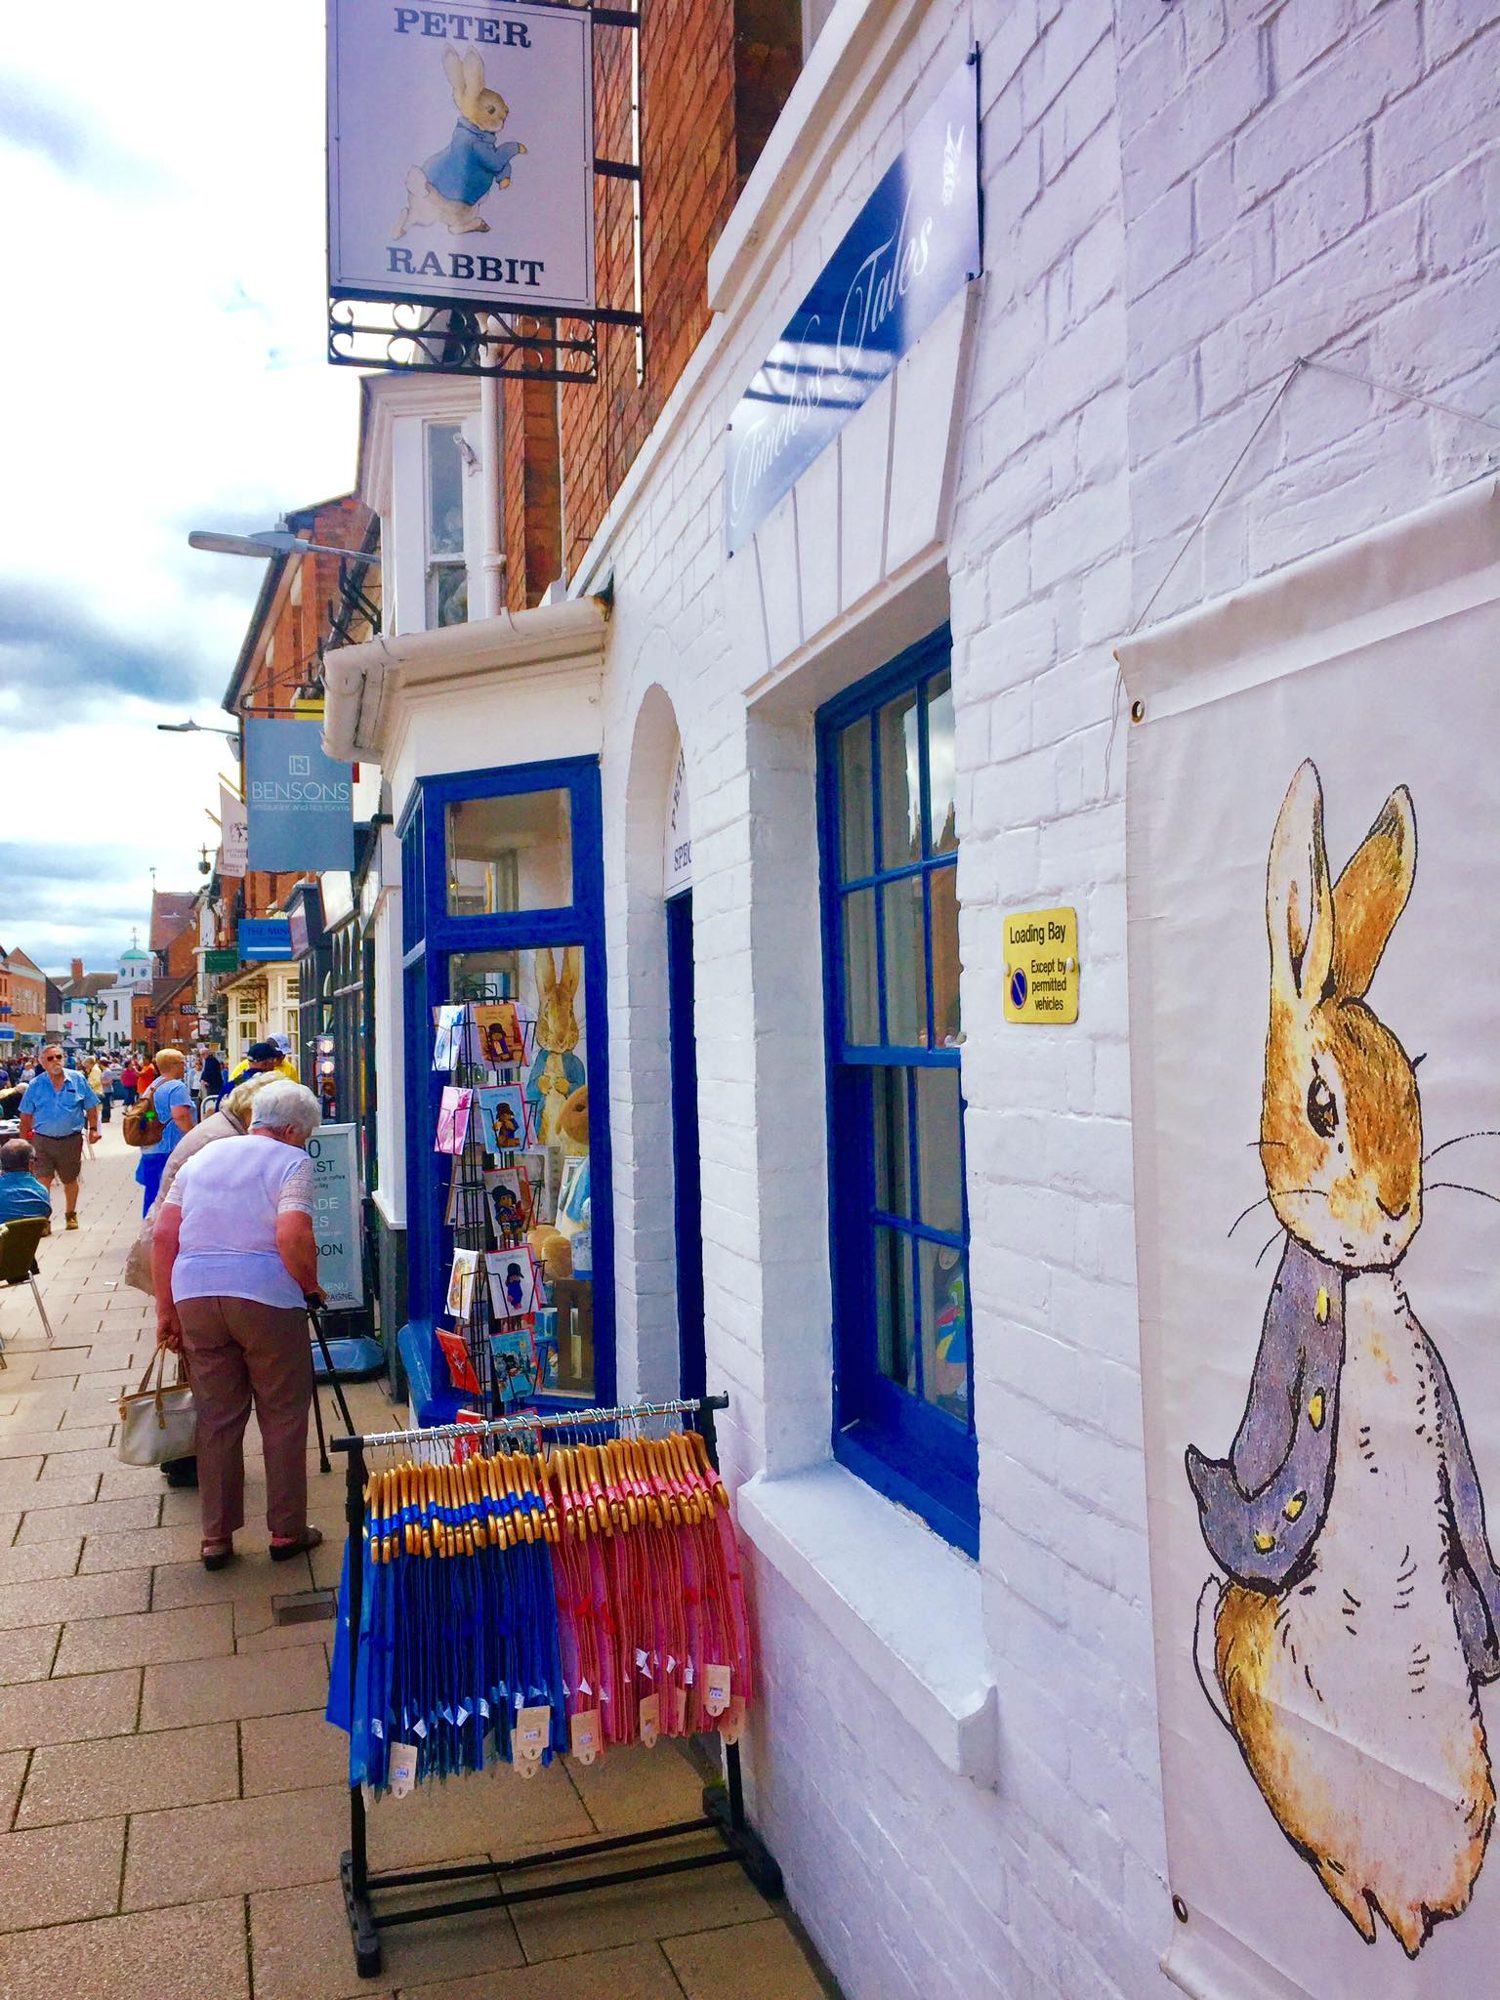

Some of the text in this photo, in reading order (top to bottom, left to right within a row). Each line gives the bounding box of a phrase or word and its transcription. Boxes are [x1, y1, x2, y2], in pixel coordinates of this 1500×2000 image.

[394, 8, 532, 48] PETER
[386, 247, 544, 286] RABBIT
[834, 184, 932, 394] Tales
[252, 781, 350, 801] BENSONS
[1010, 921, 1066, 945] Loading Bay
[1031, 957, 1067, 975] Except by
[1032, 977, 1067, 994] permitted
[1035, 996, 1064, 1011] vehicles
